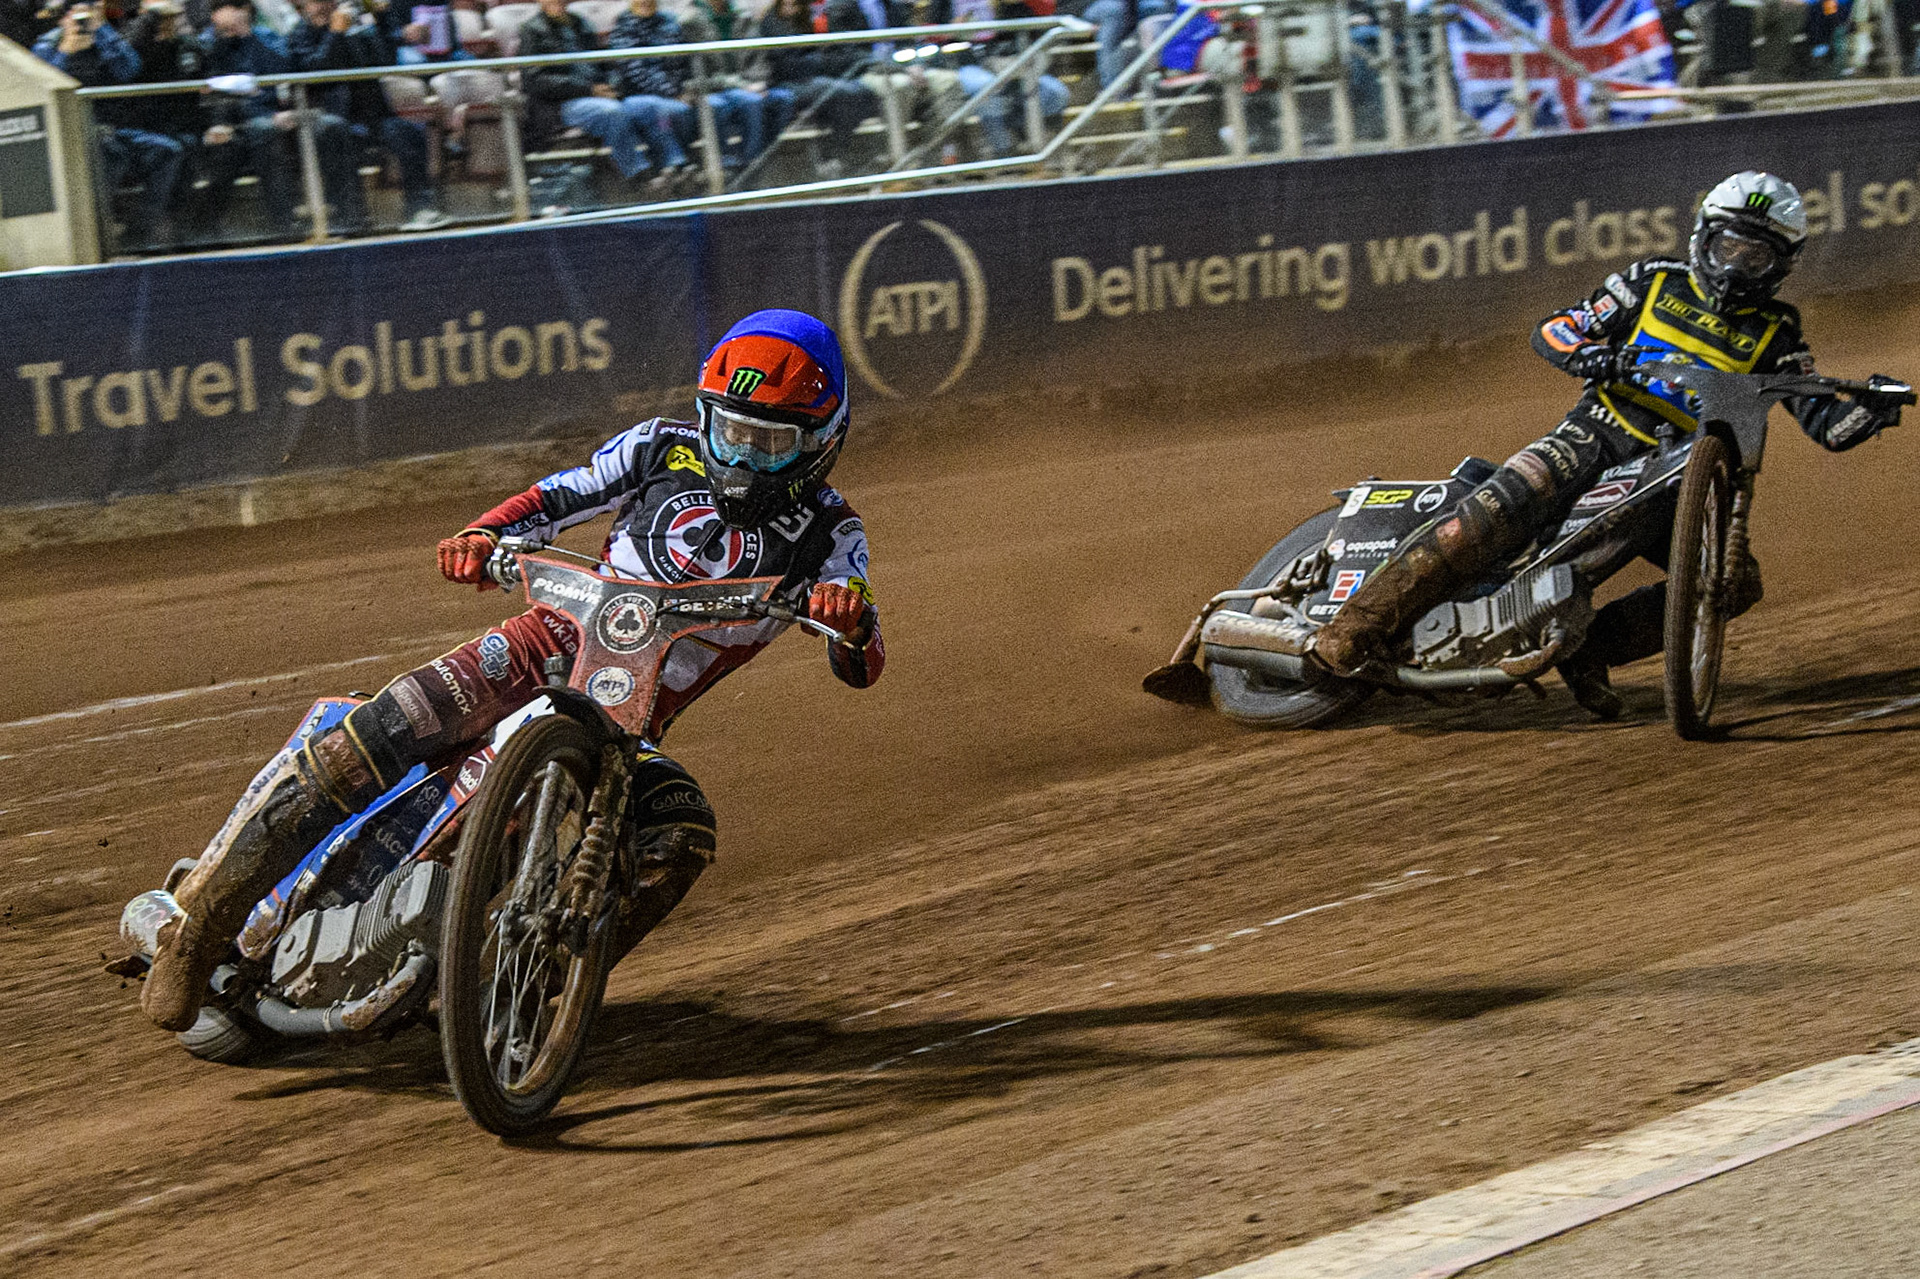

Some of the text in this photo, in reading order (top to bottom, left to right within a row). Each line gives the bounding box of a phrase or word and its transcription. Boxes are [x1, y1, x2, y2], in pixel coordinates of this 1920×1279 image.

[1053, 235, 1351, 323] Delivering
[1364, 208, 1529, 286] world
[1543, 199, 1679, 266] class
[864, 280, 960, 339] ATPI
[18, 310, 612, 436] Travel Solutions
[671, 496, 713, 512] BELLE
[1365, 489, 1414, 504] SGP
